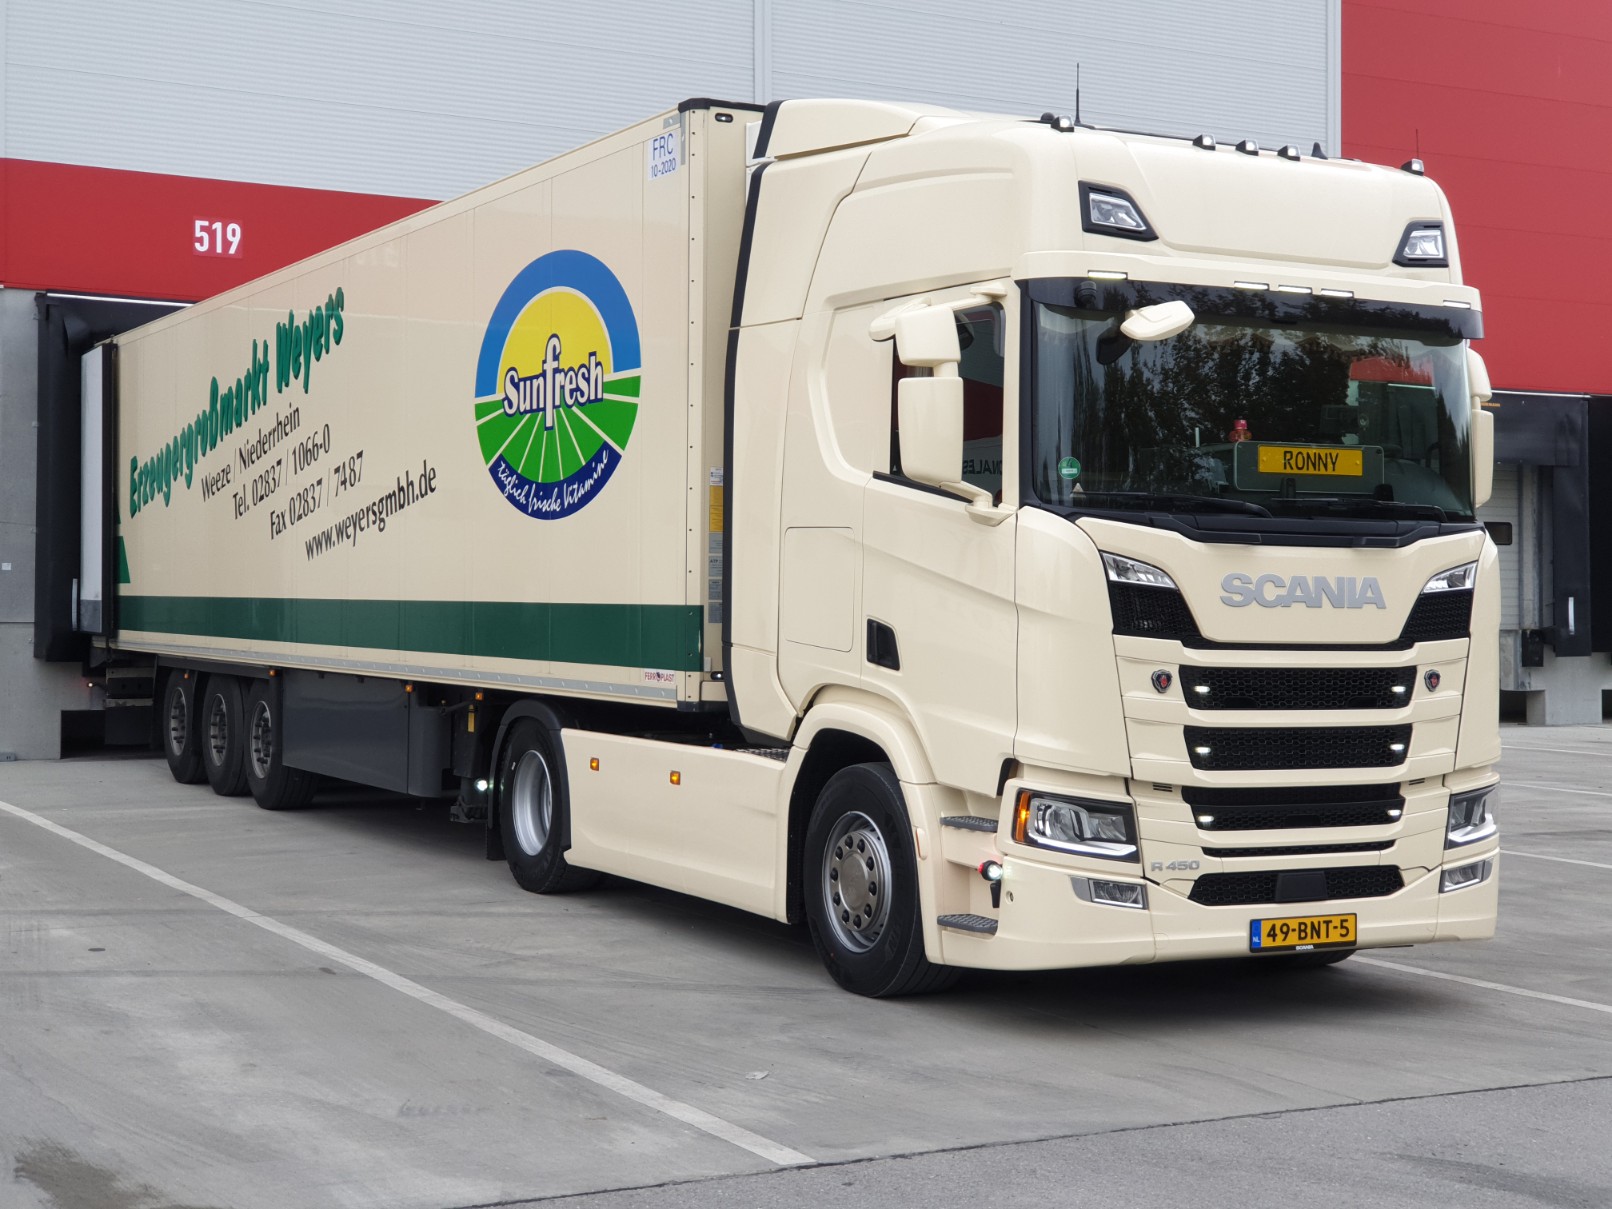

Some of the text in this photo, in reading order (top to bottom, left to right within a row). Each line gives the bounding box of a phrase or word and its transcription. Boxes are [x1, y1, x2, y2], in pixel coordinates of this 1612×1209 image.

[651, 157, 677, 178] 10-2020
[652, 132, 674, 161] FRC
[194, 219, 242, 255] 519
[276, 286, 344, 394] Weyers
[502, 333, 604, 431] Sunfresh
[201, 463, 232, 502] Weeze
[238, 402, 301, 474] Niederrhein
[232, 483, 251, 520] Tel.
[251, 457, 283, 507] 02837
[291, 423, 331, 476] 1066-0
[1283, 450, 1339, 472] RONNY
[269, 508, 287, 541] Fax
[288, 477, 323, 527] 02837
[333, 449, 364, 498] 7487
[563, 449, 610, 509] Vitamine
[304, 458, 437, 562] www.weyersgmbh.de
[1219, 572, 1388, 610] SCANIA
[1151, 860, 1200, 871] R 450
[1266, 918, 1351, 943] 49-BNT-5
